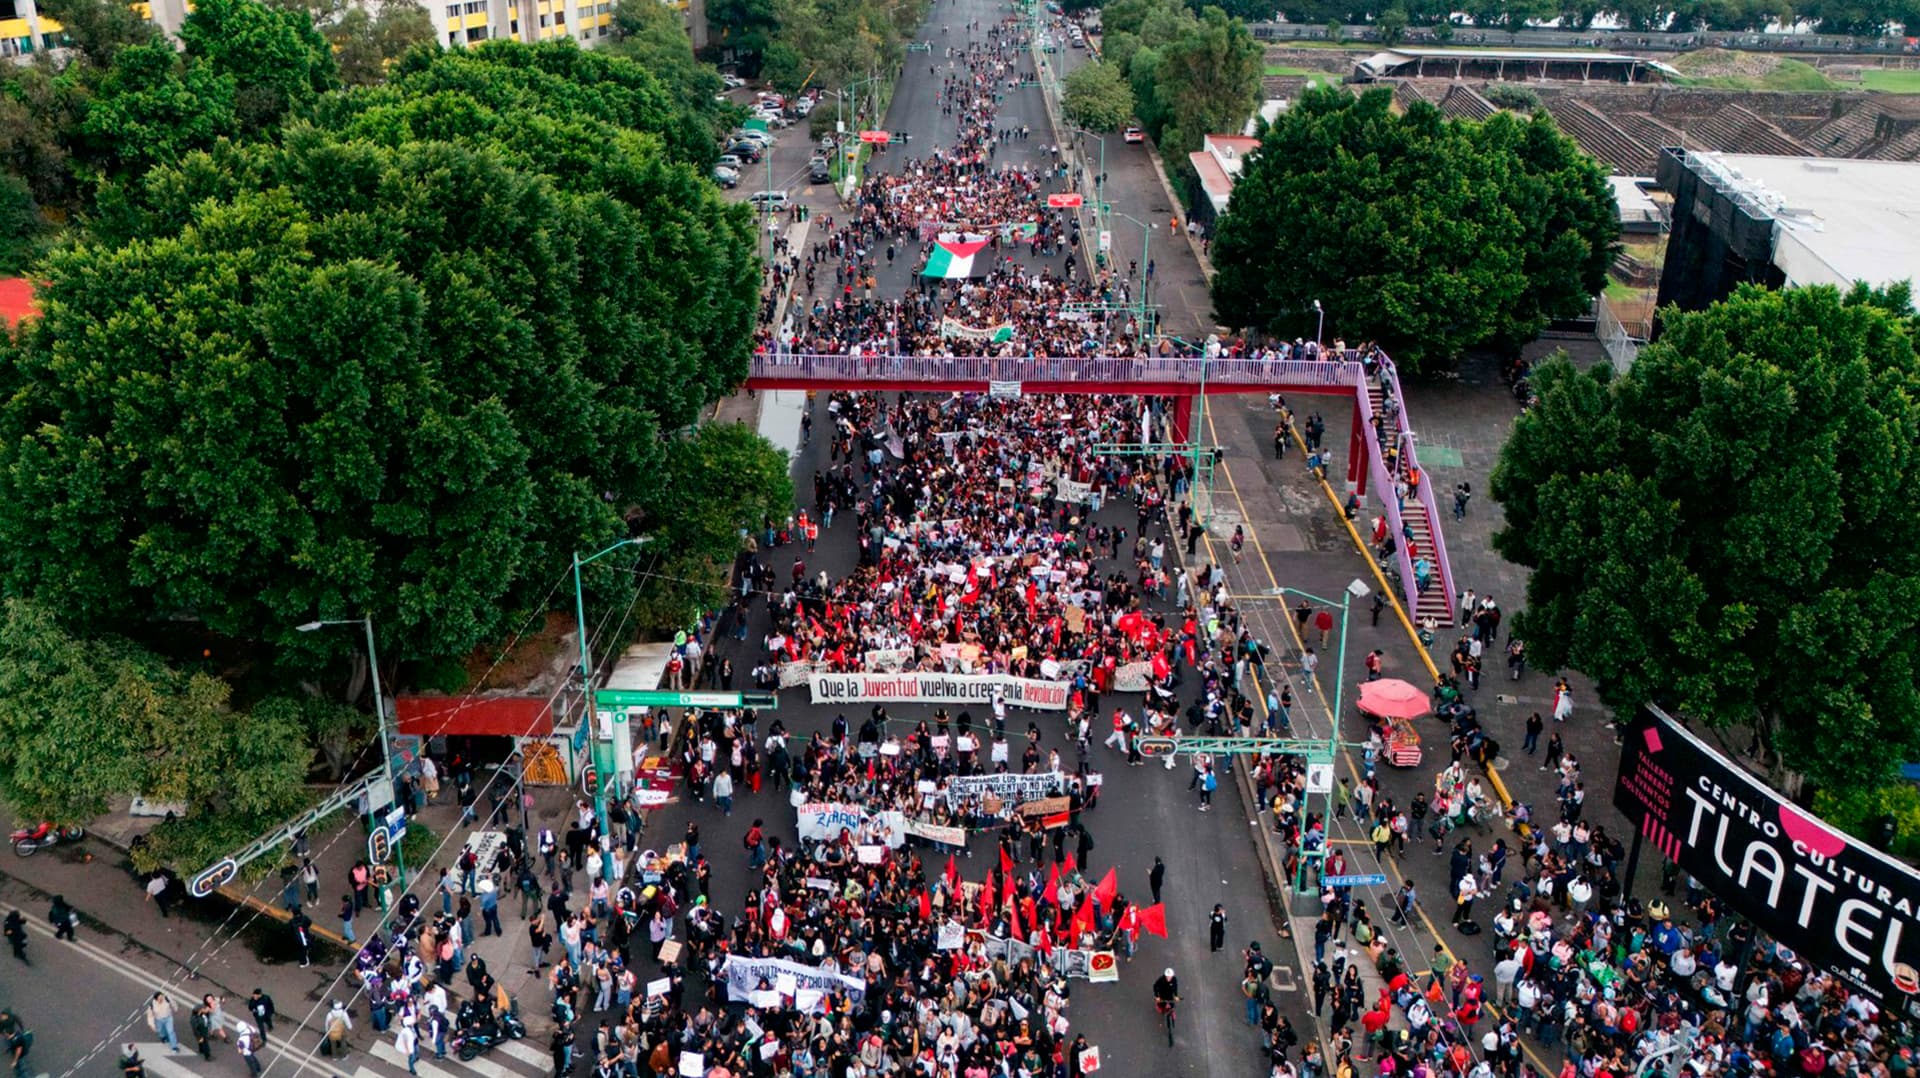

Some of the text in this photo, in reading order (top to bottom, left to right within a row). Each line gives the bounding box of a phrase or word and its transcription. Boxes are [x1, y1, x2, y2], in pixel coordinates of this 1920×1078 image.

[819, 678, 845, 698] Que
[847, 678, 859, 697] la
[861, 677, 918, 697] Juventud
[920, 678, 957, 697] vuelva
[960, 682, 967, 698] a
[1003, 682, 1013, 699] en
[1014, 682, 1022, 700] la
[1024, 682, 1065, 705] Revolución
[1002, 775, 1017, 784] LOS
[1639, 749, 1673, 785] TALLERES
[974, 784, 984, 793] LA
[1621, 775, 1667, 821] CULTURALES
[1635, 774, 1670, 809] EVENTOS
[1699, 776, 1920, 921] CENTRO CULTURA
